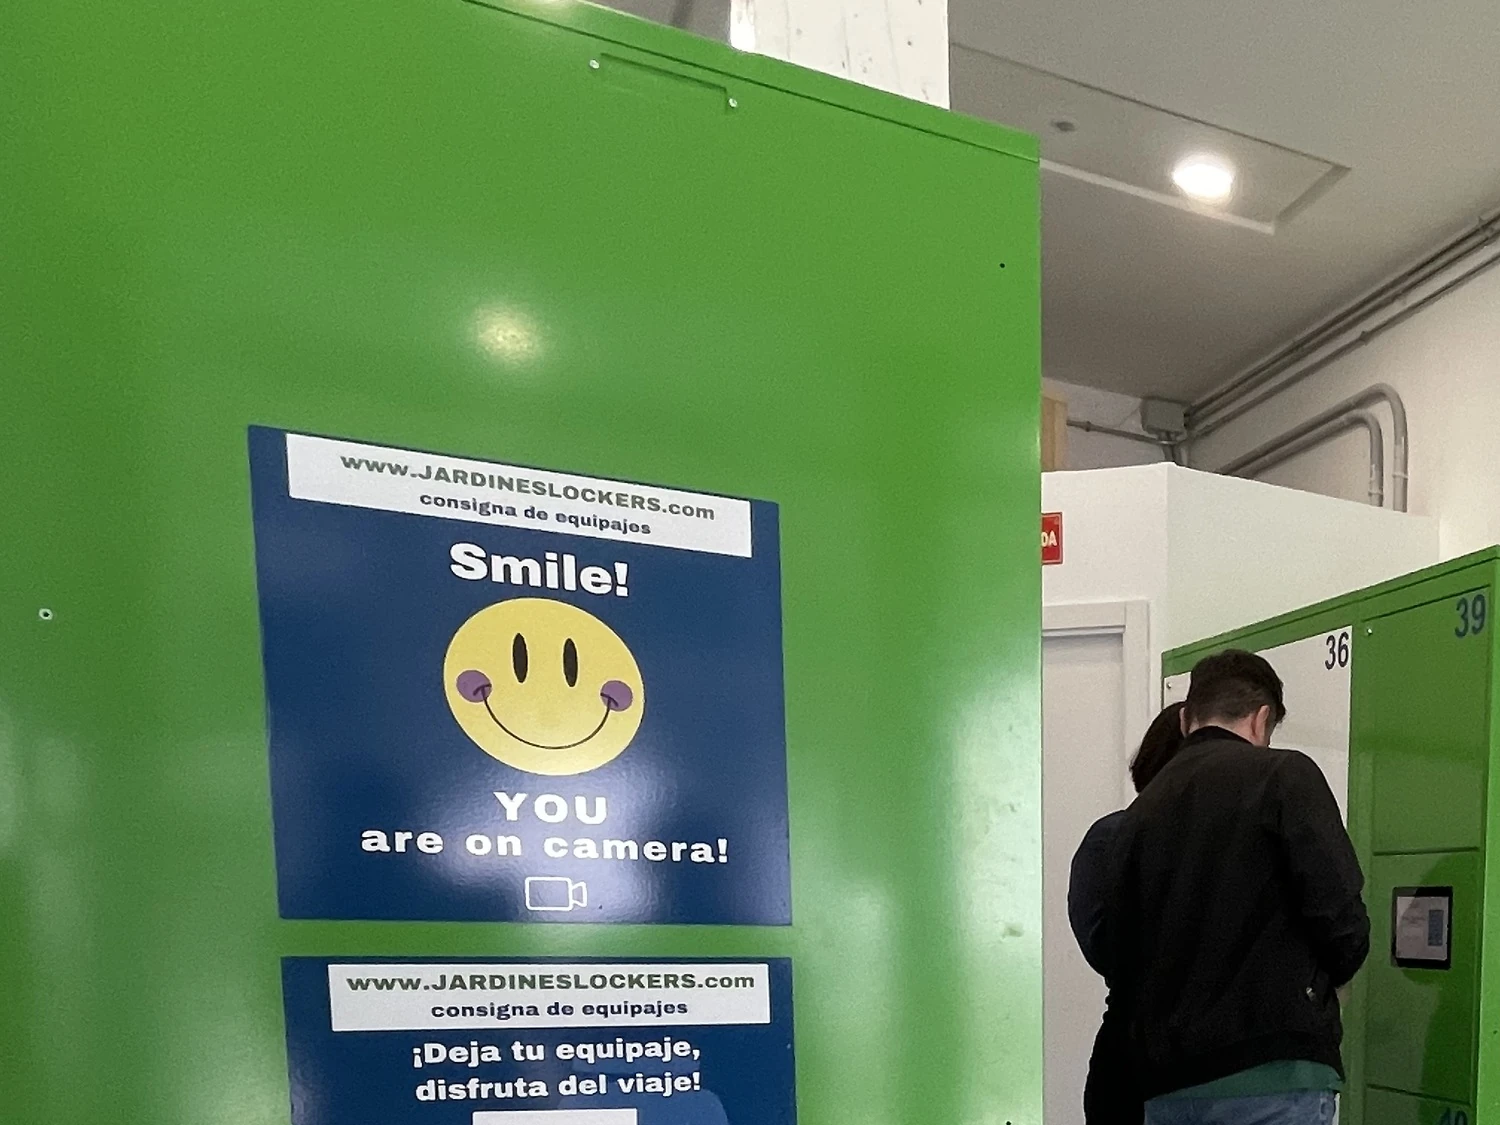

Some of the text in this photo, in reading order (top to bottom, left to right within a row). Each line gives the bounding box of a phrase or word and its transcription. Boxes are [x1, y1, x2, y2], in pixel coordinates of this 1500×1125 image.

[340, 453, 715, 521] www.JARDINESLOCKERS.com
[420, 493, 652, 536] consigna de equipajes
[449, 541, 629, 597] Smile!
[1454, 593, 1486, 639] 39
[1325, 631, 1349, 670] 36
[493, 791, 607, 825] YOU
[361, 830, 728, 864] are on camera!
[346, 972, 755, 991] www.JARDINESLOCKERS.com
[431, 999, 688, 1020] consigna de equipajes
[412, 1037, 701, 1068] ¡Deja tu equipaje,
[416, 1072, 701, 1102] disfruta del viaje!
